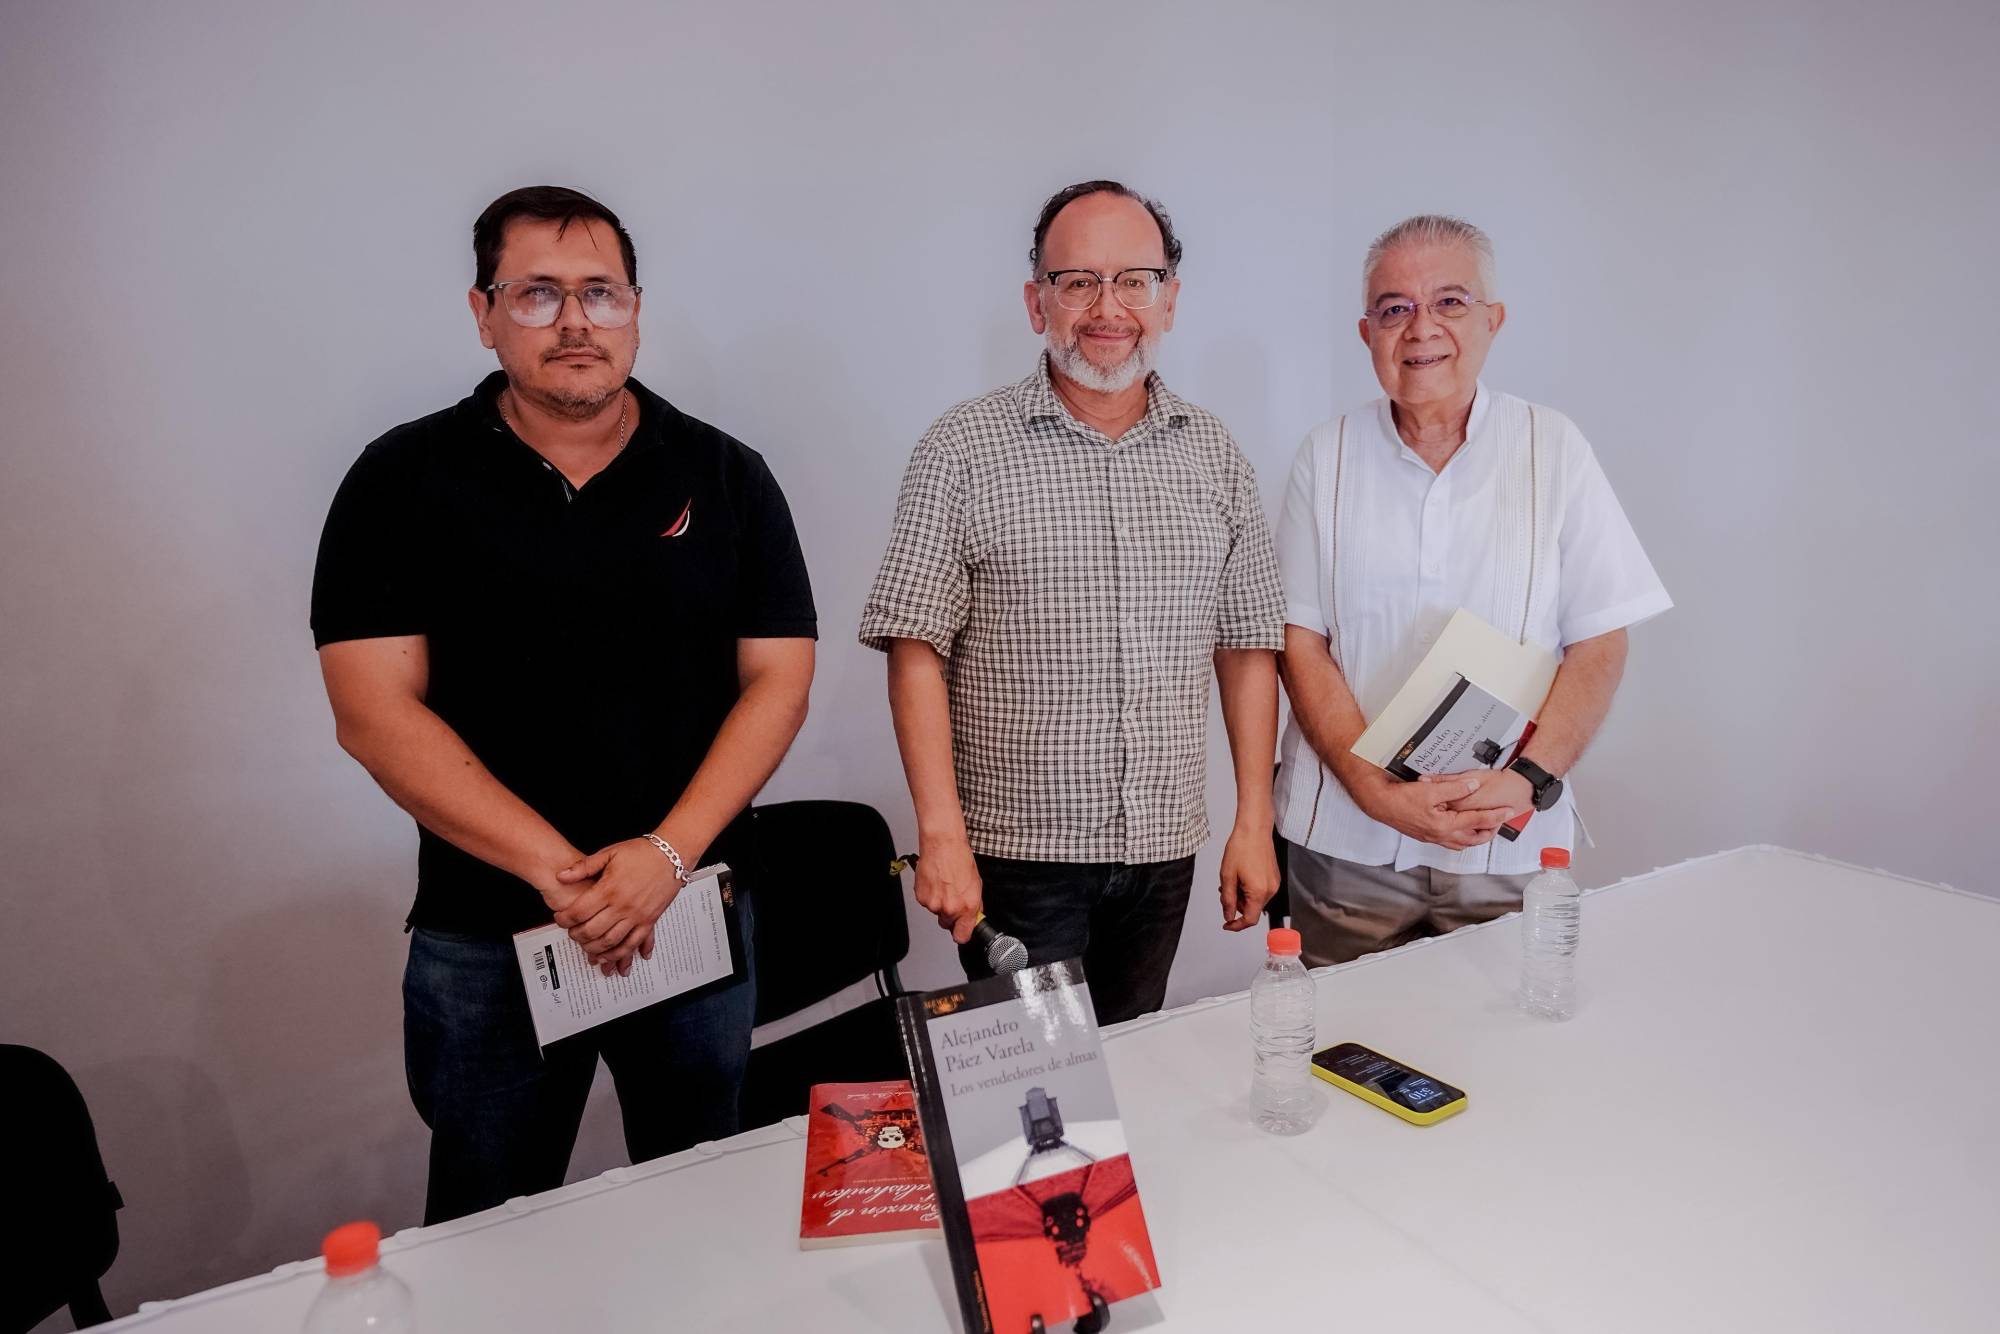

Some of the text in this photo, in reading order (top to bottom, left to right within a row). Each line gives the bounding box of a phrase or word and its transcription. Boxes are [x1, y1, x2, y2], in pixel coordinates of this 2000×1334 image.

[1414, 729, 1451, 767] Alejandro
[1440, 729, 1465, 752] Varela
[941, 1020, 1019, 1050] Alejandro
[943, 1038, 1035, 1073] Páez Varela
[950, 1050, 1099, 1097] Los vendedores de almas
[1407, 1086, 1434, 1101] 5:10
[826, 1207, 856, 1227] de
